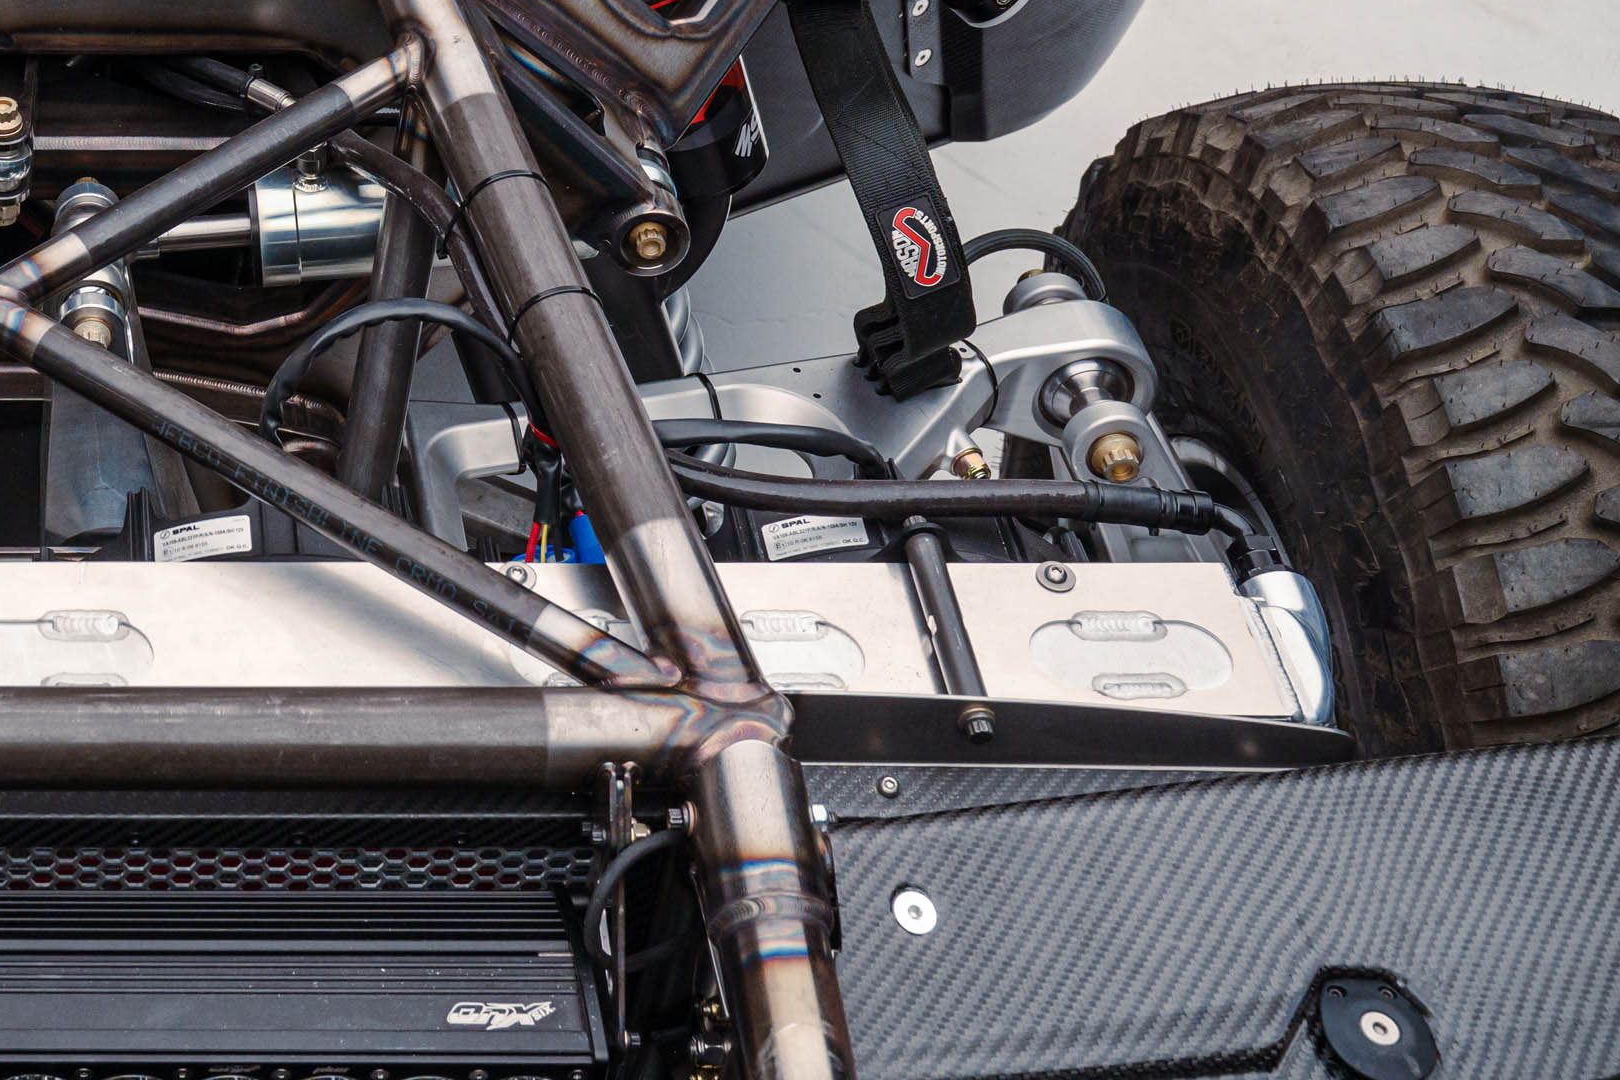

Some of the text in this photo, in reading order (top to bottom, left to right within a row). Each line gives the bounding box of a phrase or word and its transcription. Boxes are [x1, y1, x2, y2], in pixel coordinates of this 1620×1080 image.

[914, 210, 947, 275] MOTORSPORTS
[171, 524, 200, 536] SPAL
[781, 518, 811, 530] SPAL
